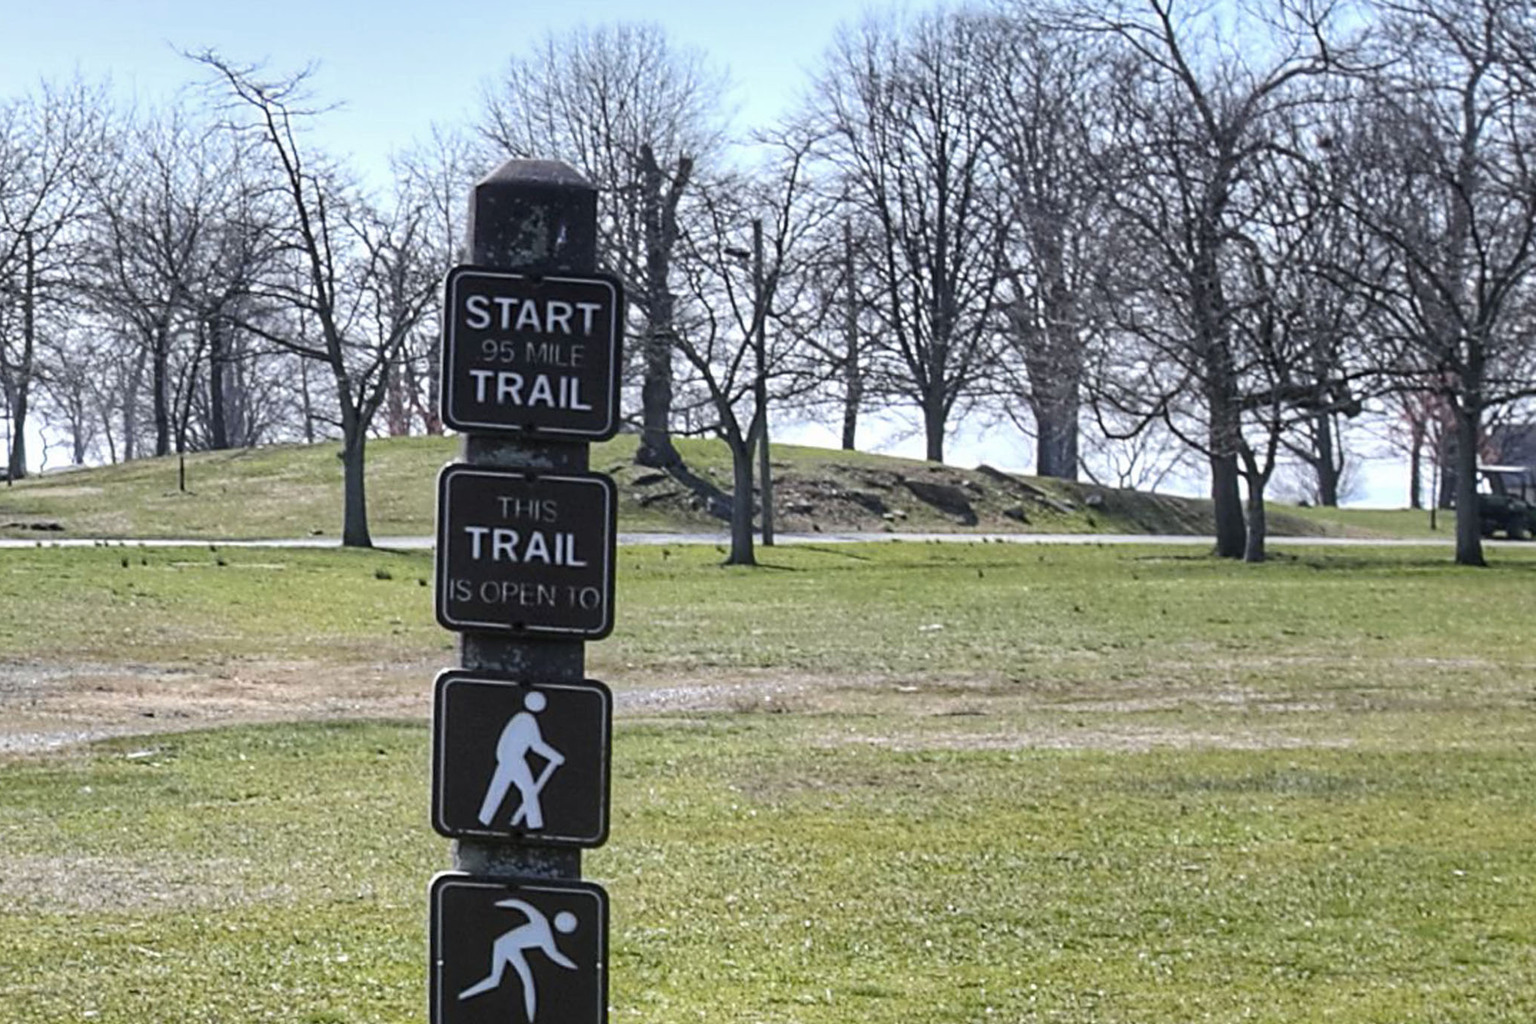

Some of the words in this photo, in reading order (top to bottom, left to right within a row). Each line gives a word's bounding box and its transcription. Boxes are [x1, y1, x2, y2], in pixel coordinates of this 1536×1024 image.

[465, 295, 602, 336] START
[525, 341, 585, 368] MILE
[469, 369, 592, 411] TRAIL
[497, 496, 557, 523] THIS
[464, 526, 587, 567] TRAIL
[449, 579, 473, 602] IS
[480, 580, 556, 607] OPEN
[567, 585, 601, 610] TO
